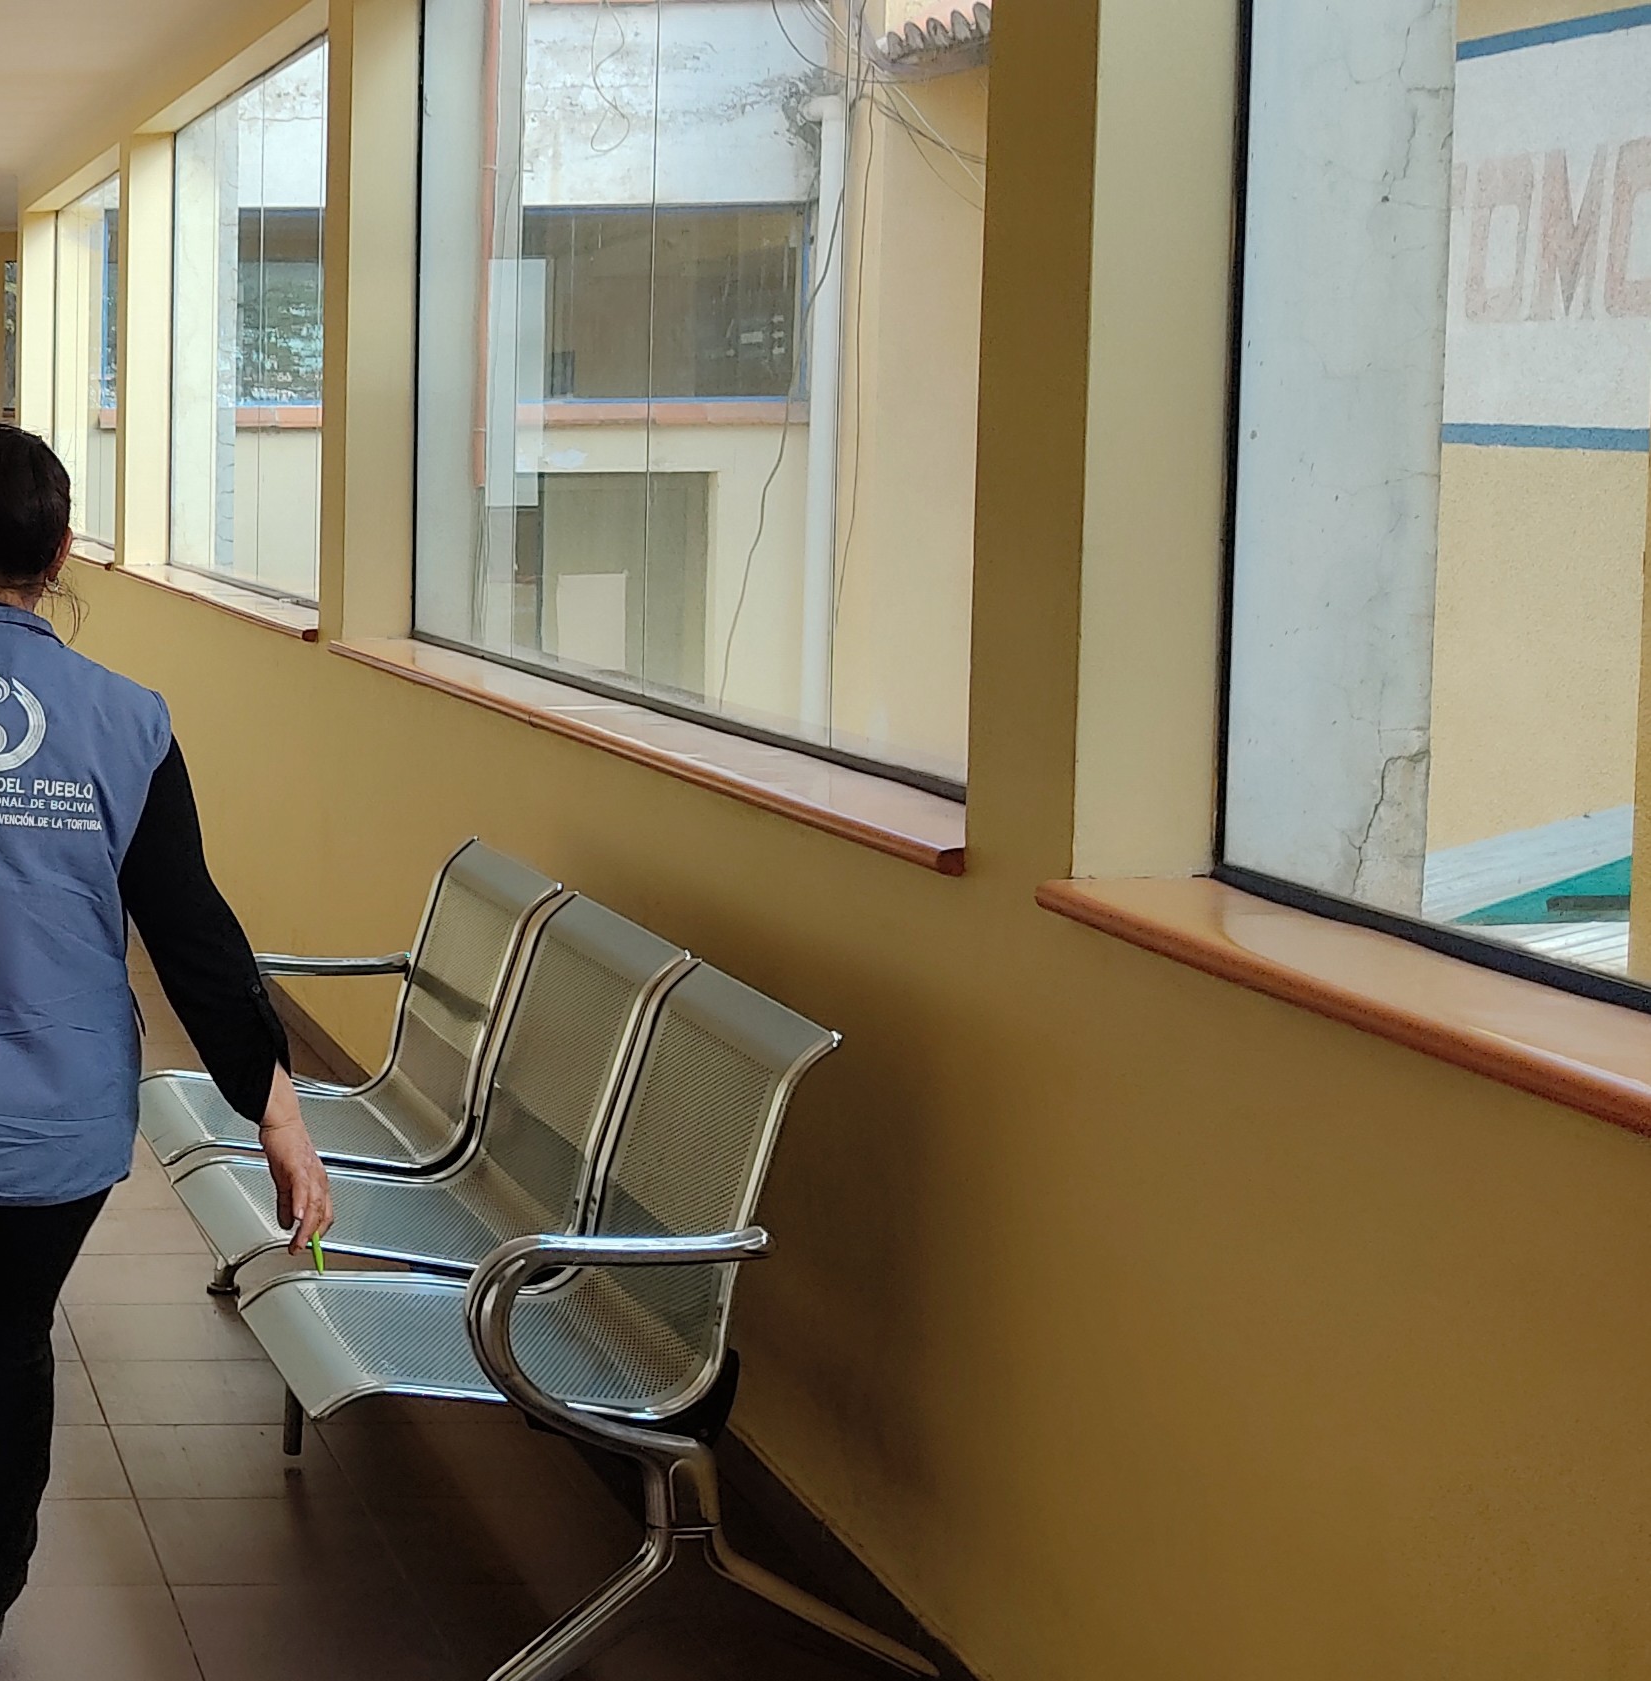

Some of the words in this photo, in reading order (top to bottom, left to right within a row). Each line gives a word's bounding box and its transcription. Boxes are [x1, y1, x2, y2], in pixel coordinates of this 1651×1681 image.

[33, 779, 94, 799] PUEBLO
[30, 798, 46, 810] DE
[50, 800, 95, 813] BOLIVIA
[37, 816, 49, 828] DE
[51, 817, 63, 829] LA
[67, 818, 103, 831] TORTURA
